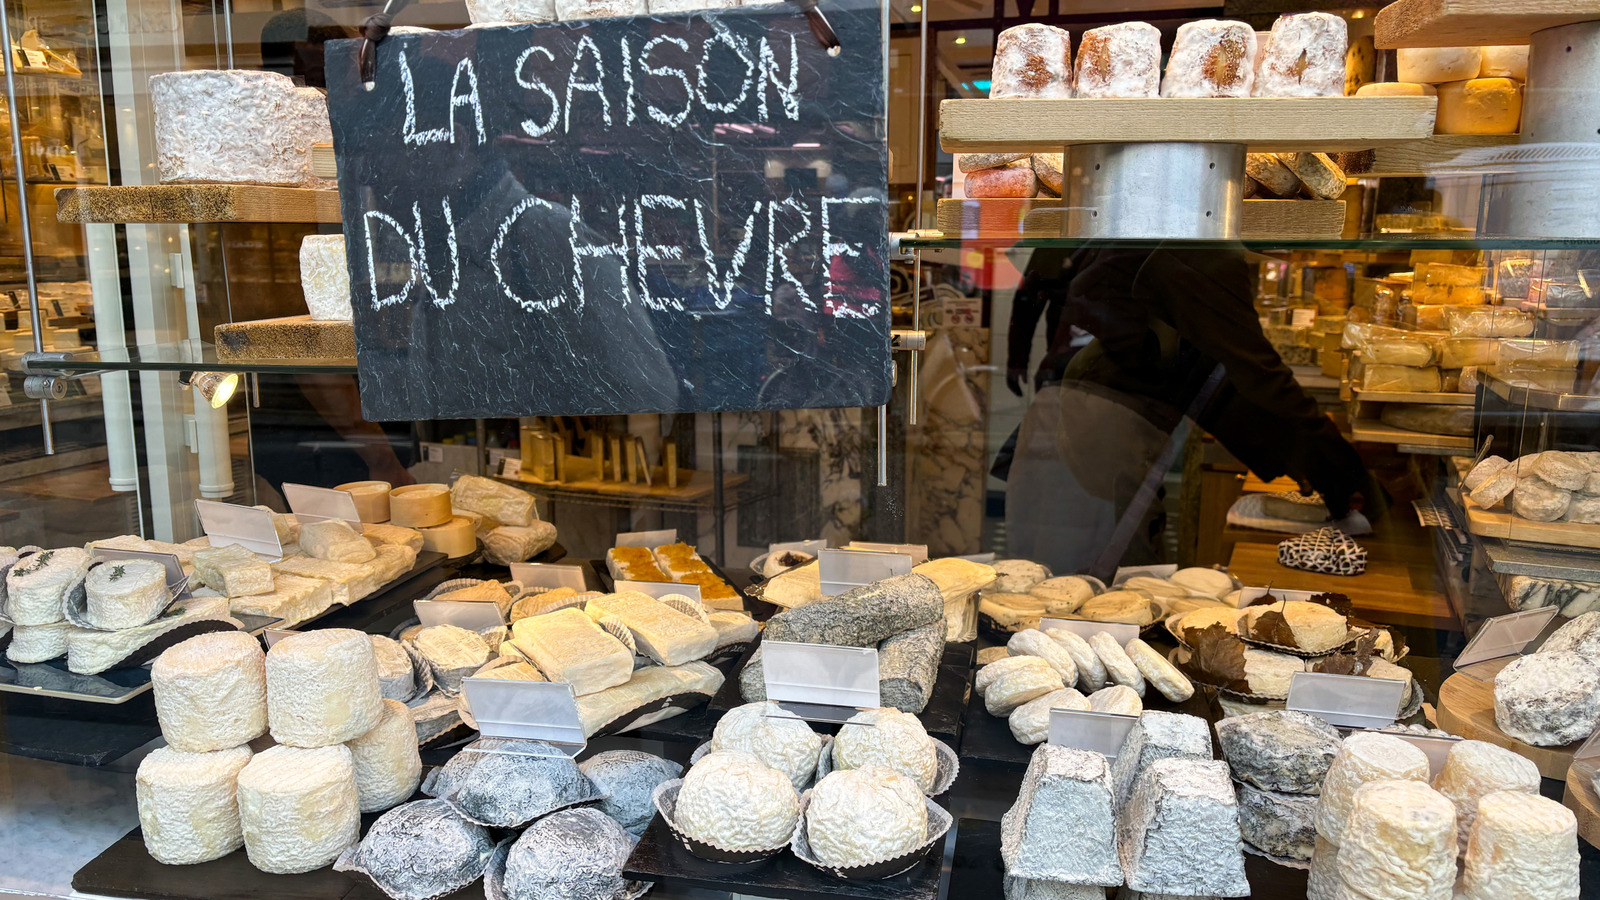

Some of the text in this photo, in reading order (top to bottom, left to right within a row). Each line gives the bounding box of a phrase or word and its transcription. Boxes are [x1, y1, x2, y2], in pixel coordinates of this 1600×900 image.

[400, 30, 800, 145] LA SAISON
[363, 194, 881, 320] DU CHEVRE
